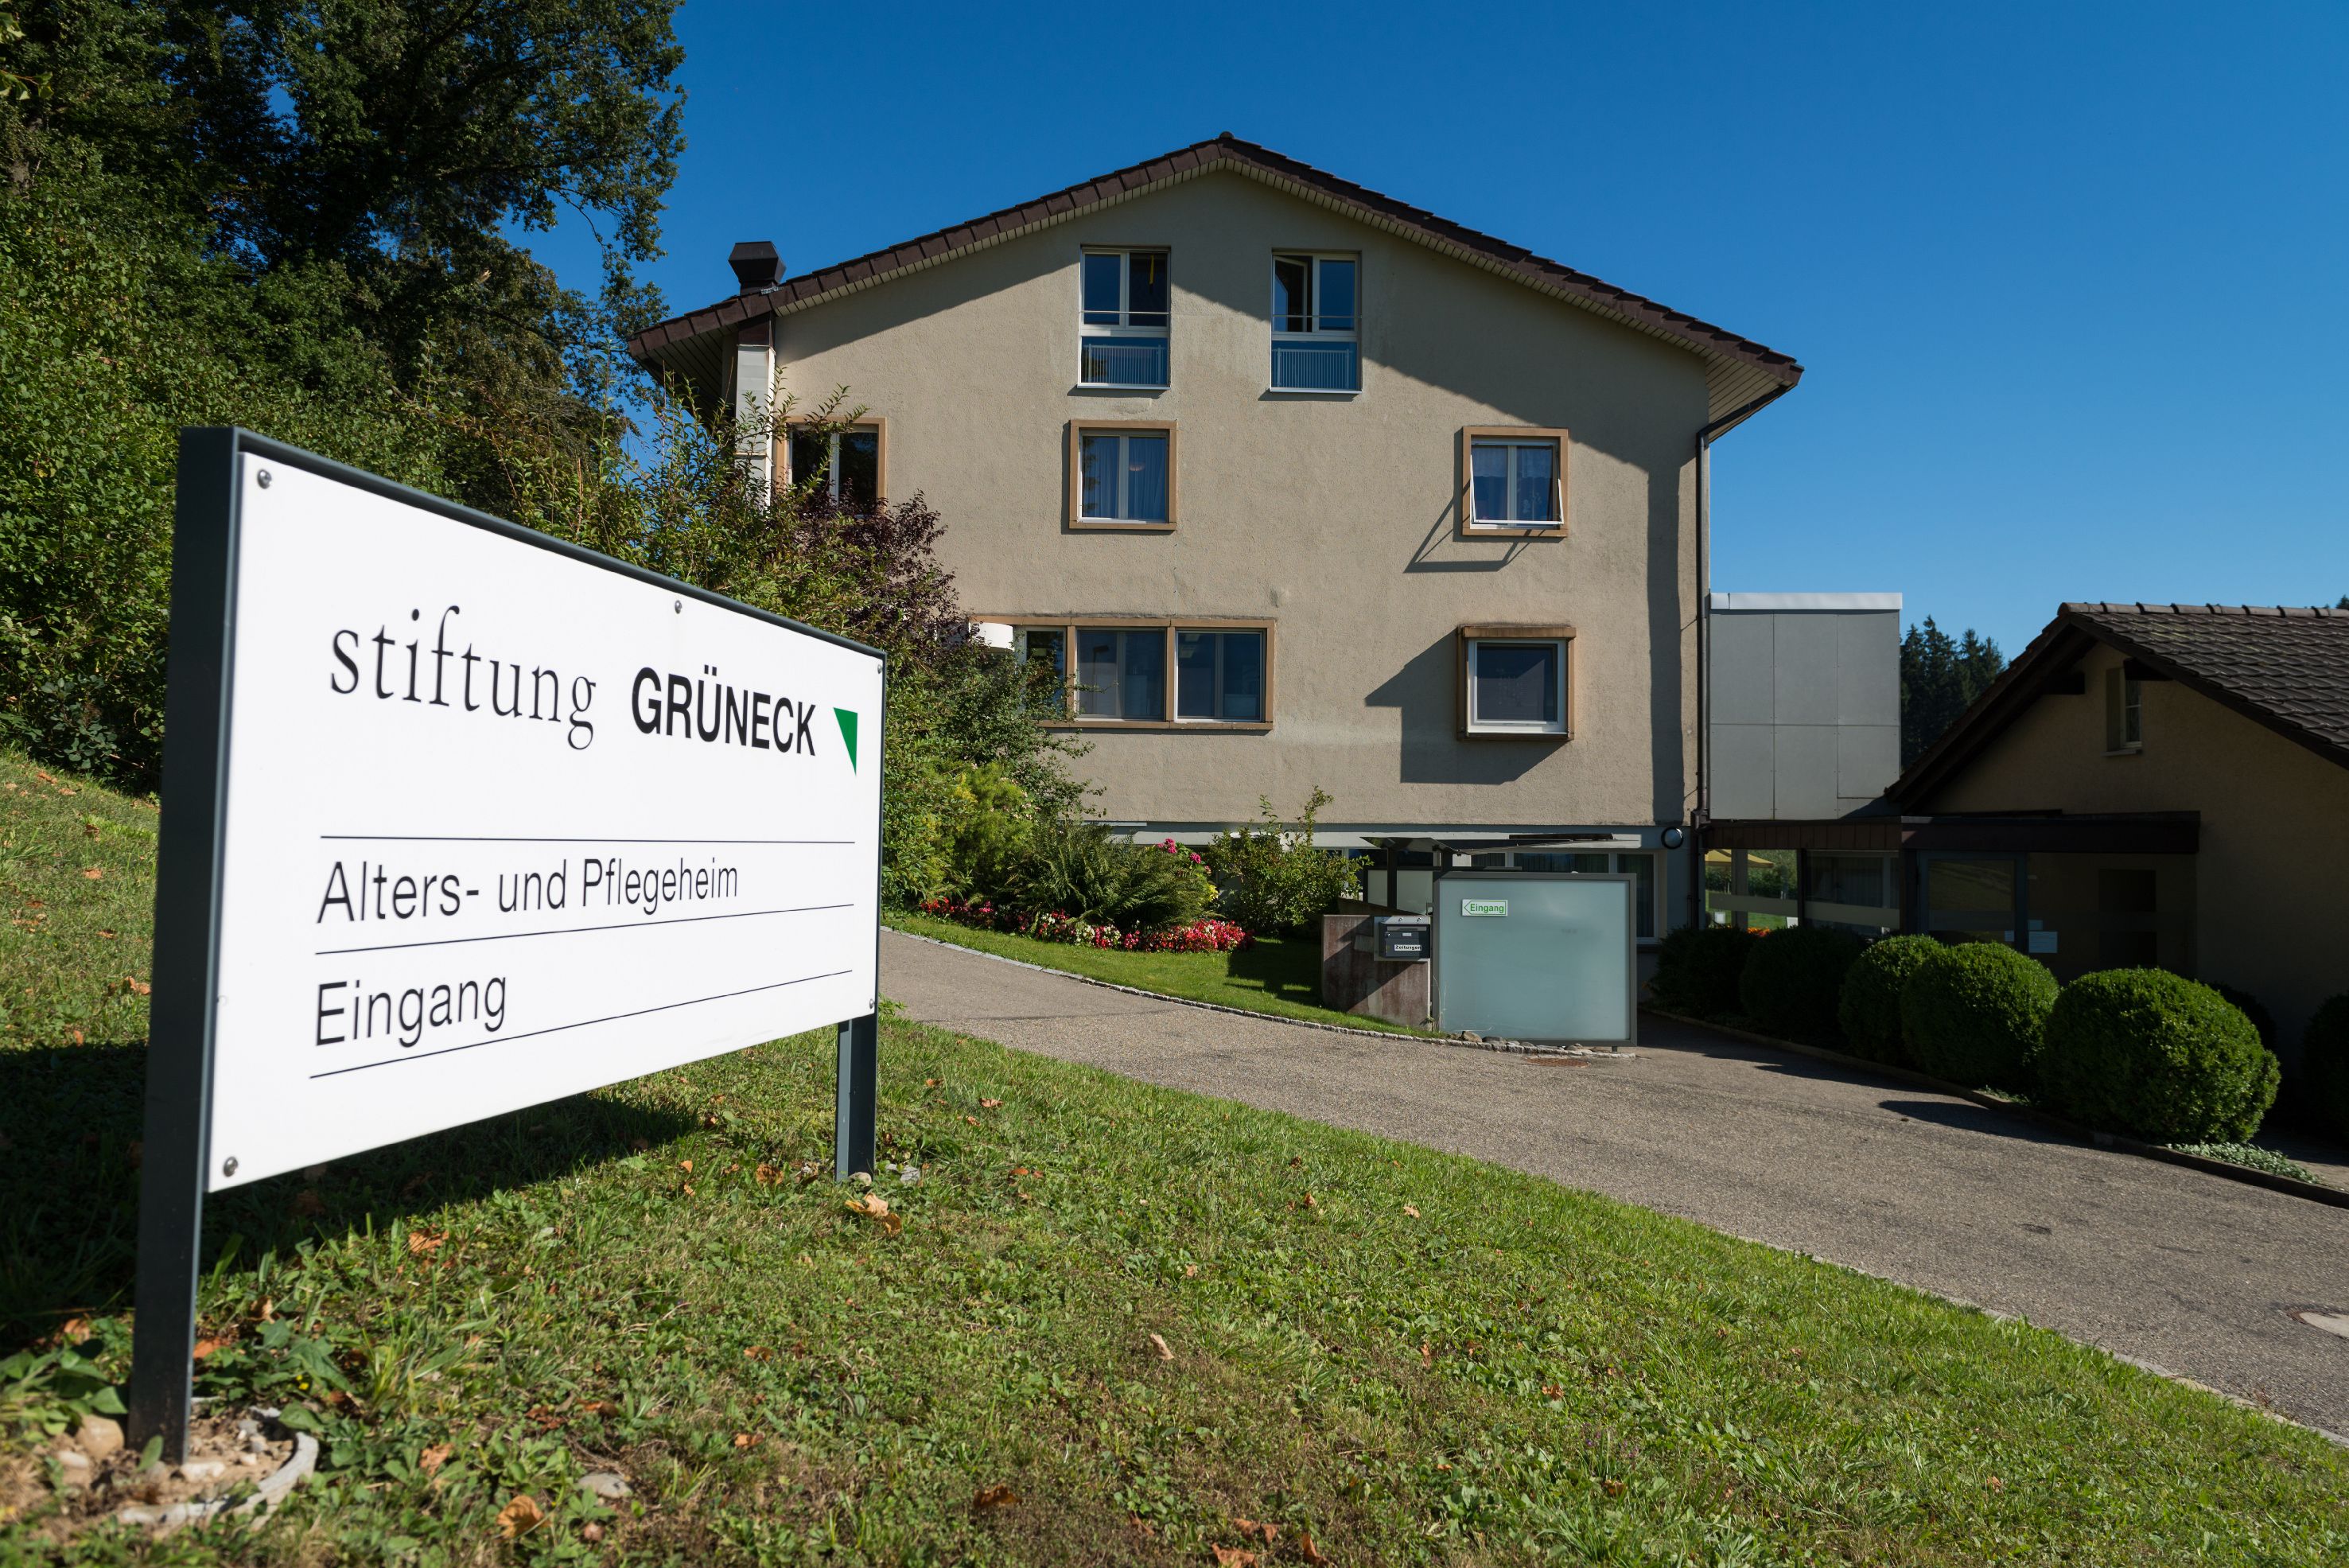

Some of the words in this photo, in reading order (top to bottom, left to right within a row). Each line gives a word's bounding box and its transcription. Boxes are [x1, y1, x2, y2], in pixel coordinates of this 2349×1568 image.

[330, 605, 597, 750] stiftung
[632, 664, 816, 757] GRÜNECK
[317, 860, 480, 924] Alters-
[498, 858, 567, 912] und
[582, 857, 738, 915] Pflegeheim
[1470, 903, 1504, 913] Eingang
[315, 976, 507, 1049] Eingang
